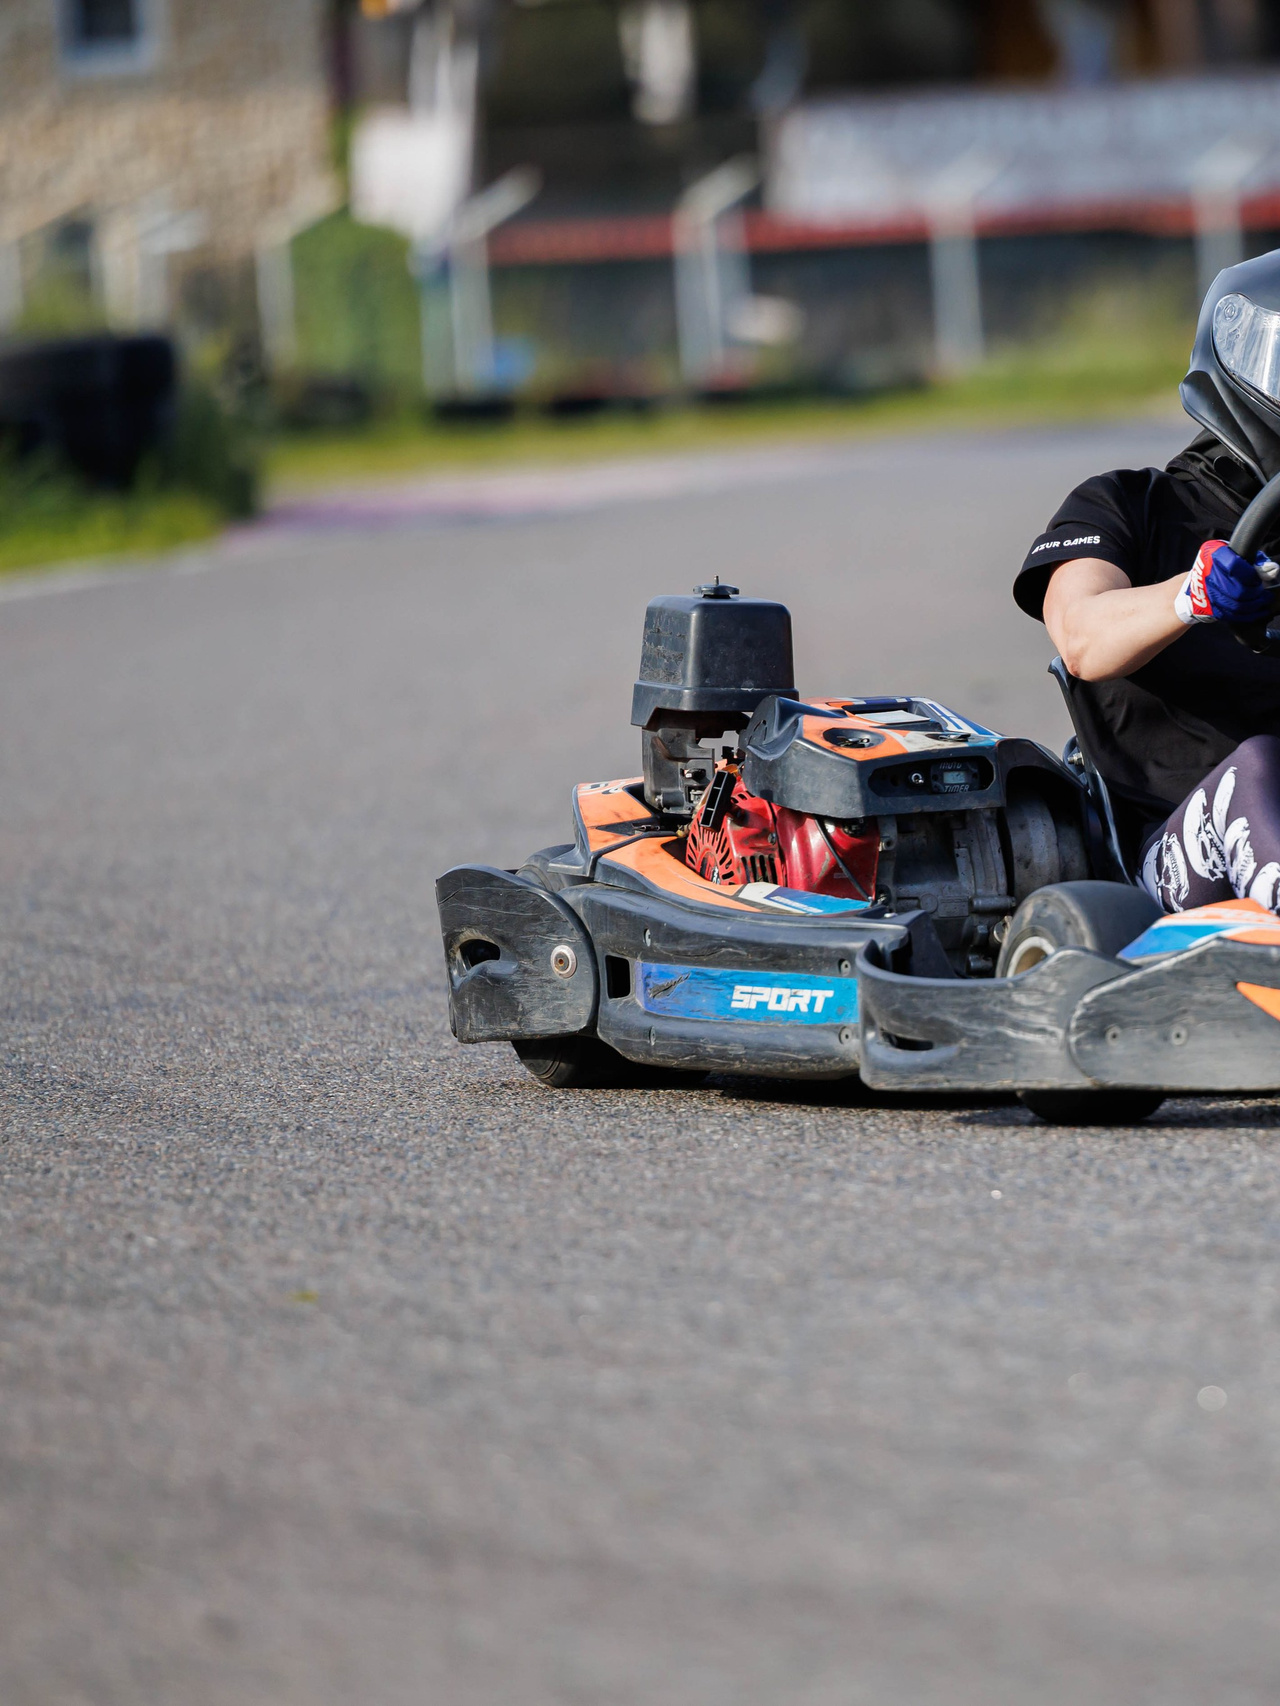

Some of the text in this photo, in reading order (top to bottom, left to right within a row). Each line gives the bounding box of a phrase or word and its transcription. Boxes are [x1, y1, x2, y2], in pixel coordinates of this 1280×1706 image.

[1031, 535, 1101, 555] AZUR GAMES
[943, 784, 971, 793] TIMER
[730, 984, 835, 1013] SPORT
